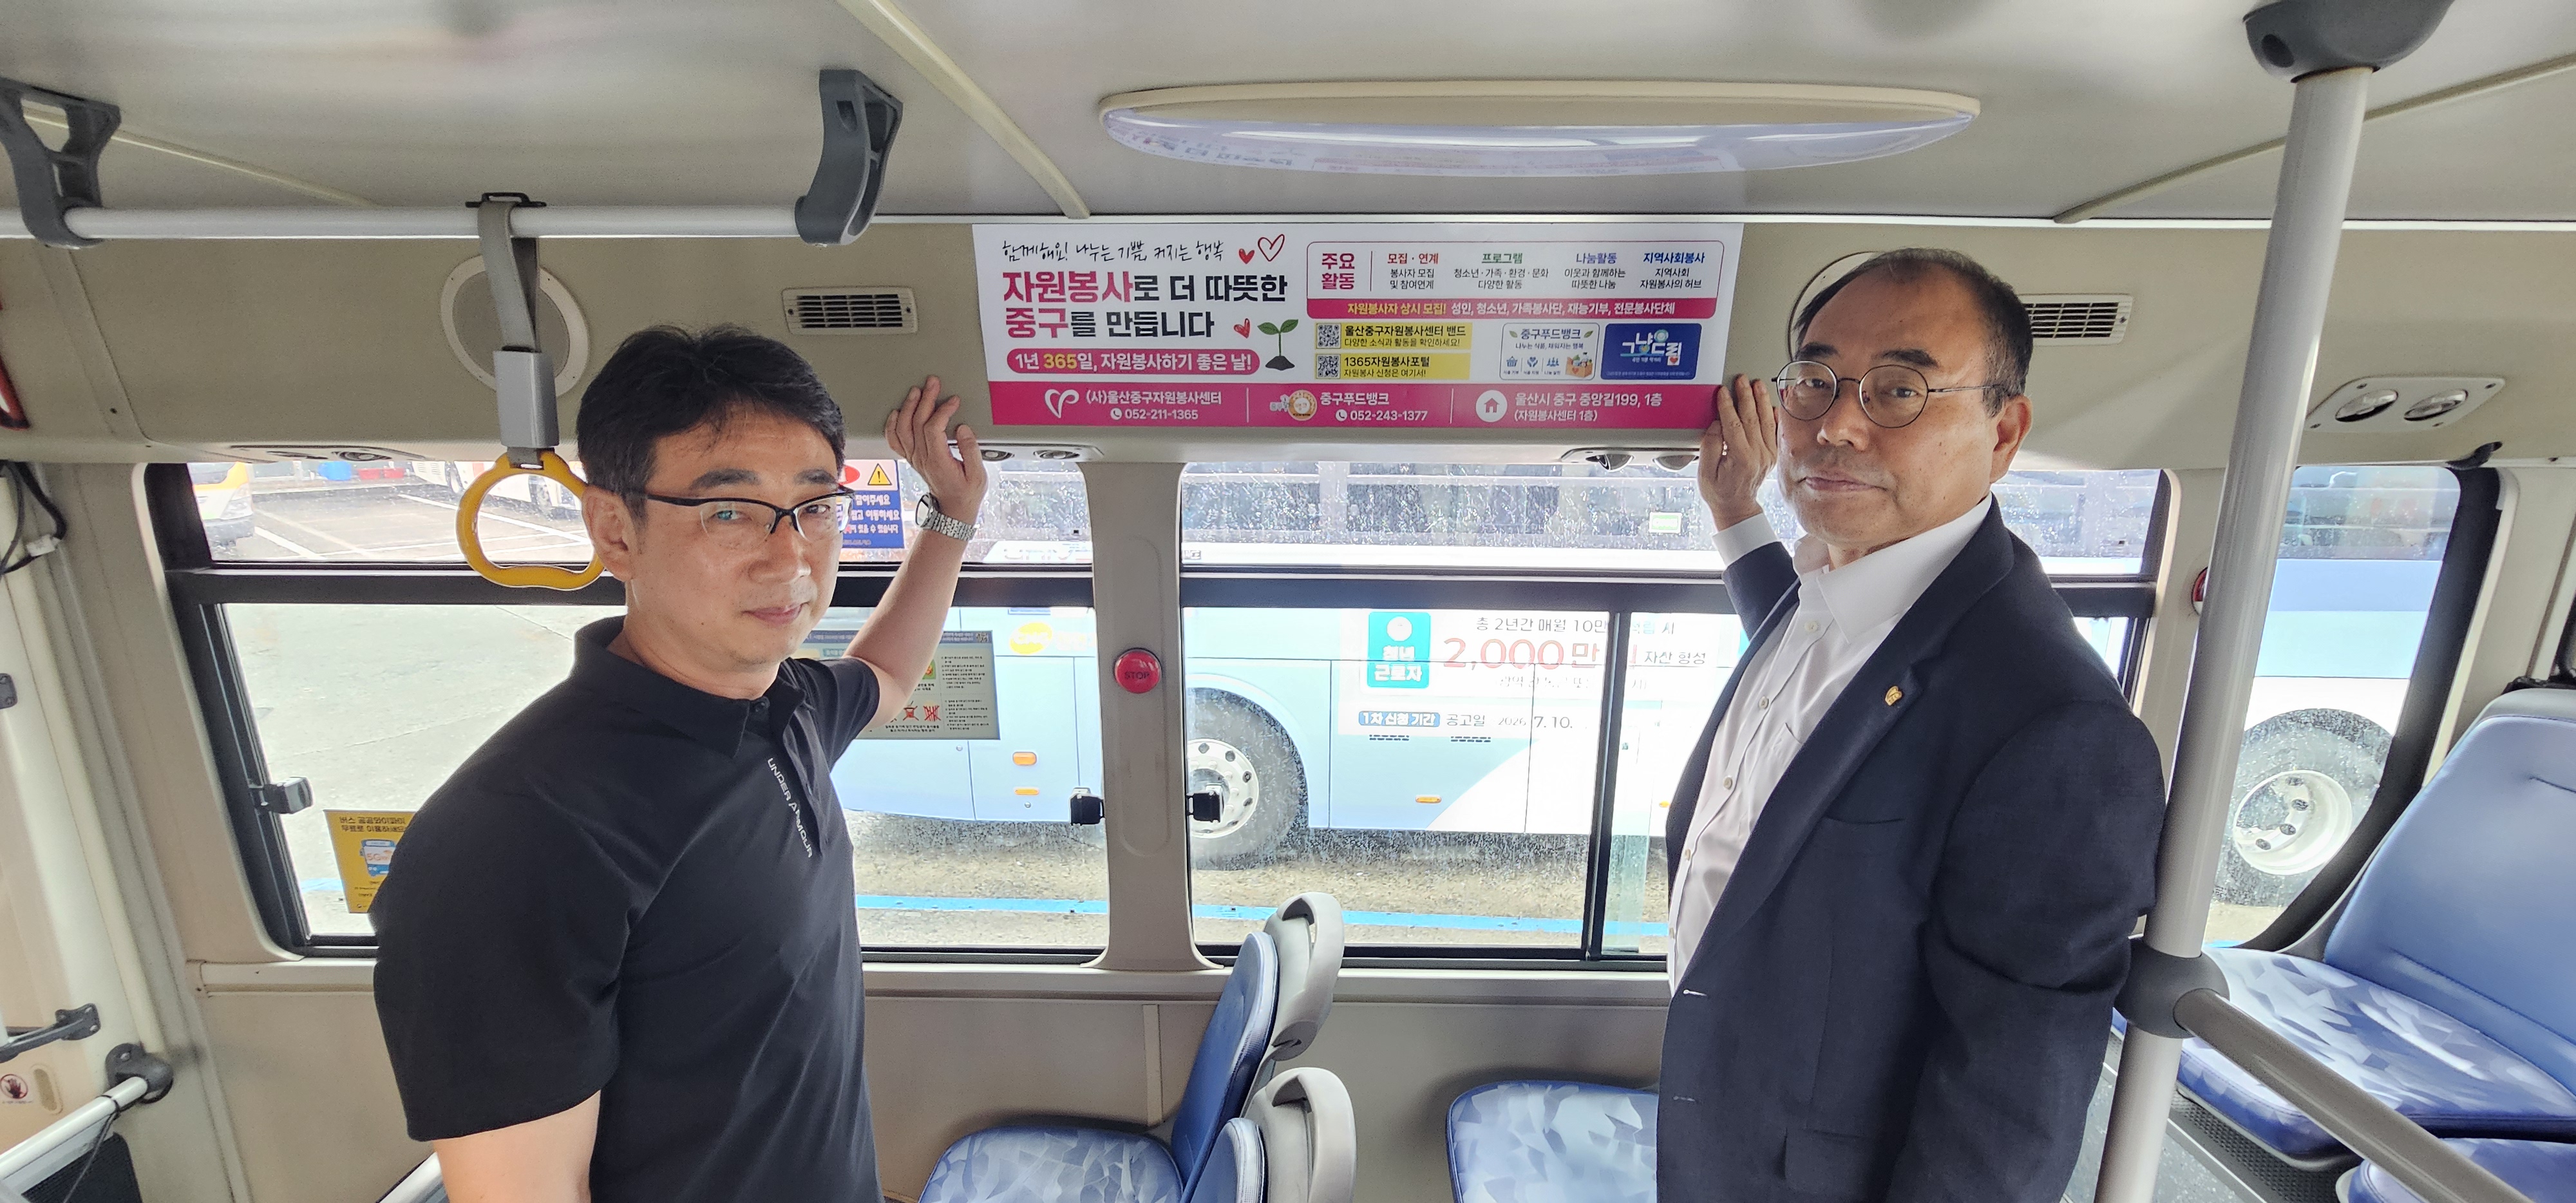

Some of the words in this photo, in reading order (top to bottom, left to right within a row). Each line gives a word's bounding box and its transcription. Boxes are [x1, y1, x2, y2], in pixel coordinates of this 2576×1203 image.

[1002, 240, 1068, 261] 함께해요!
[1076, 242, 1114, 261] 나누는
[1154, 244, 1192, 261] 커지는
[1196, 240, 1224, 261] 행복
[1321, 252, 1355, 270] 주요
[1387, 253, 1408, 265] 모집
[1418, 253, 1439, 265] 연계
[1481, 252, 1523, 265] 프로그램
[1576, 252, 1617, 265] 나눔활동
[1643, 252, 1705, 264] 지역사회봉사
[1390, 269, 1416, 278] 봉사자
[1417, 269, 1435, 278] 모집
[1454, 269, 1480, 278] 청소년
[1485, 269, 1502, 278] 가족
[1508, 269, 1526, 278] 환경
[1531, 269, 1549, 278] 문화
[1564, 269, 1589, 278] 이웃과
[1592, 269, 1626, 278] 함께하는
[1655, 268, 1689, 278] 지역사회
[1003, 270, 1160, 303] 자원봉사로
[1170, 275, 1195, 301] 더
[1206, 274, 1287, 302] 따뜻한
[1321, 272, 1355, 290] 활동
[1390, 280, 1398, 290] 및
[1400, 280, 1434, 290] 참여연계
[1477, 280, 1504, 290] 다양한
[1506, 280, 1523, 290] 활동
[1571, 280, 1597, 289] 따뜻한
[1599, 280, 1616, 289] 나눔
[1640, 279, 1682, 289] 자원봉사의
[1685, 279, 1702, 289] 허브
[1347, 303, 1398, 315] 자원봉사자
[1400, 303, 1421, 315] 상시
[1423, 303, 1447, 315] 모집!
[1452, 303, 1474, 316] 성인,
[1476, 303, 1510, 316] 청소년,
[1512, 303, 1566, 316] 가족봉사단,
[1567, 302, 1611, 316] 재능기부,
[1614, 302, 1675, 315] 전문봉사단체
[1005, 308, 1096, 339] 중구를
[1106, 311, 1215, 337] 만듭니다
[1345, 326, 1444, 337] 울산중구자원봉사센터
[1446, 326, 1466, 336] 밴드
[1520, 328, 1581, 339] 중구푸드뱅크
[1345, 339, 1367, 347] 다양한
[1370, 339, 1392, 347] 소식과
[1394, 339, 1417, 347] 활동을
[1419, 338, 1460, 346] 확인하세요!
[1015, 353, 1039, 371] 1년
[1043, 352, 1097, 372] 365일,
[1101, 352, 1193, 372] 자원봉사하기
[1197, 353, 1227, 371] 좋은
[1231, 353, 1252, 371] 날!
[1344, 357, 1430, 368] 1365자원봉사포털
[1343, 369, 1374, 377] 자원봉사
[1376, 369, 1399, 377] 신청은
[1401, 369, 1426, 377] 여기서!
[1086, 390, 1222, 405] (사)울산중구자원봉사센터
[1320, 392, 1389, 405] 중구푸드뱅크
[1515, 392, 1550, 406] 울산시
[1553, 392, 1577, 406] 중구
[1580, 393, 1641, 408] 중앙길199,
[1645, 393, 1662, 406] 1층
[1124, 409, 1198, 420] 052-211-1365
[1350, 410, 1428, 421] 052-243-1377
[1514, 410, 1577, 422] (자원봉사센터
[1579, 410, 1597, 422] 1층)
[1476, 617, 1489, 632] 총
[1495, 617, 1534, 632] 2년간
[1538, 617, 1567, 632] 매월
[1645, 651, 1672, 664] 자산
[1678, 652, 1706, 665] 형성
[1124, 672, 1150, 680] STOP
[1374, 665, 1423, 683] 근로자
[1363, 712, 1383, 725] 1차
[1385, 712, 1410, 726] 신청
[1412, 713, 1436, 726] 기간
[1446, 714, 1485, 727] 공고일
[768, 758, 791, 801] UNDER
[788, 802, 813, 858] ARMOUR
